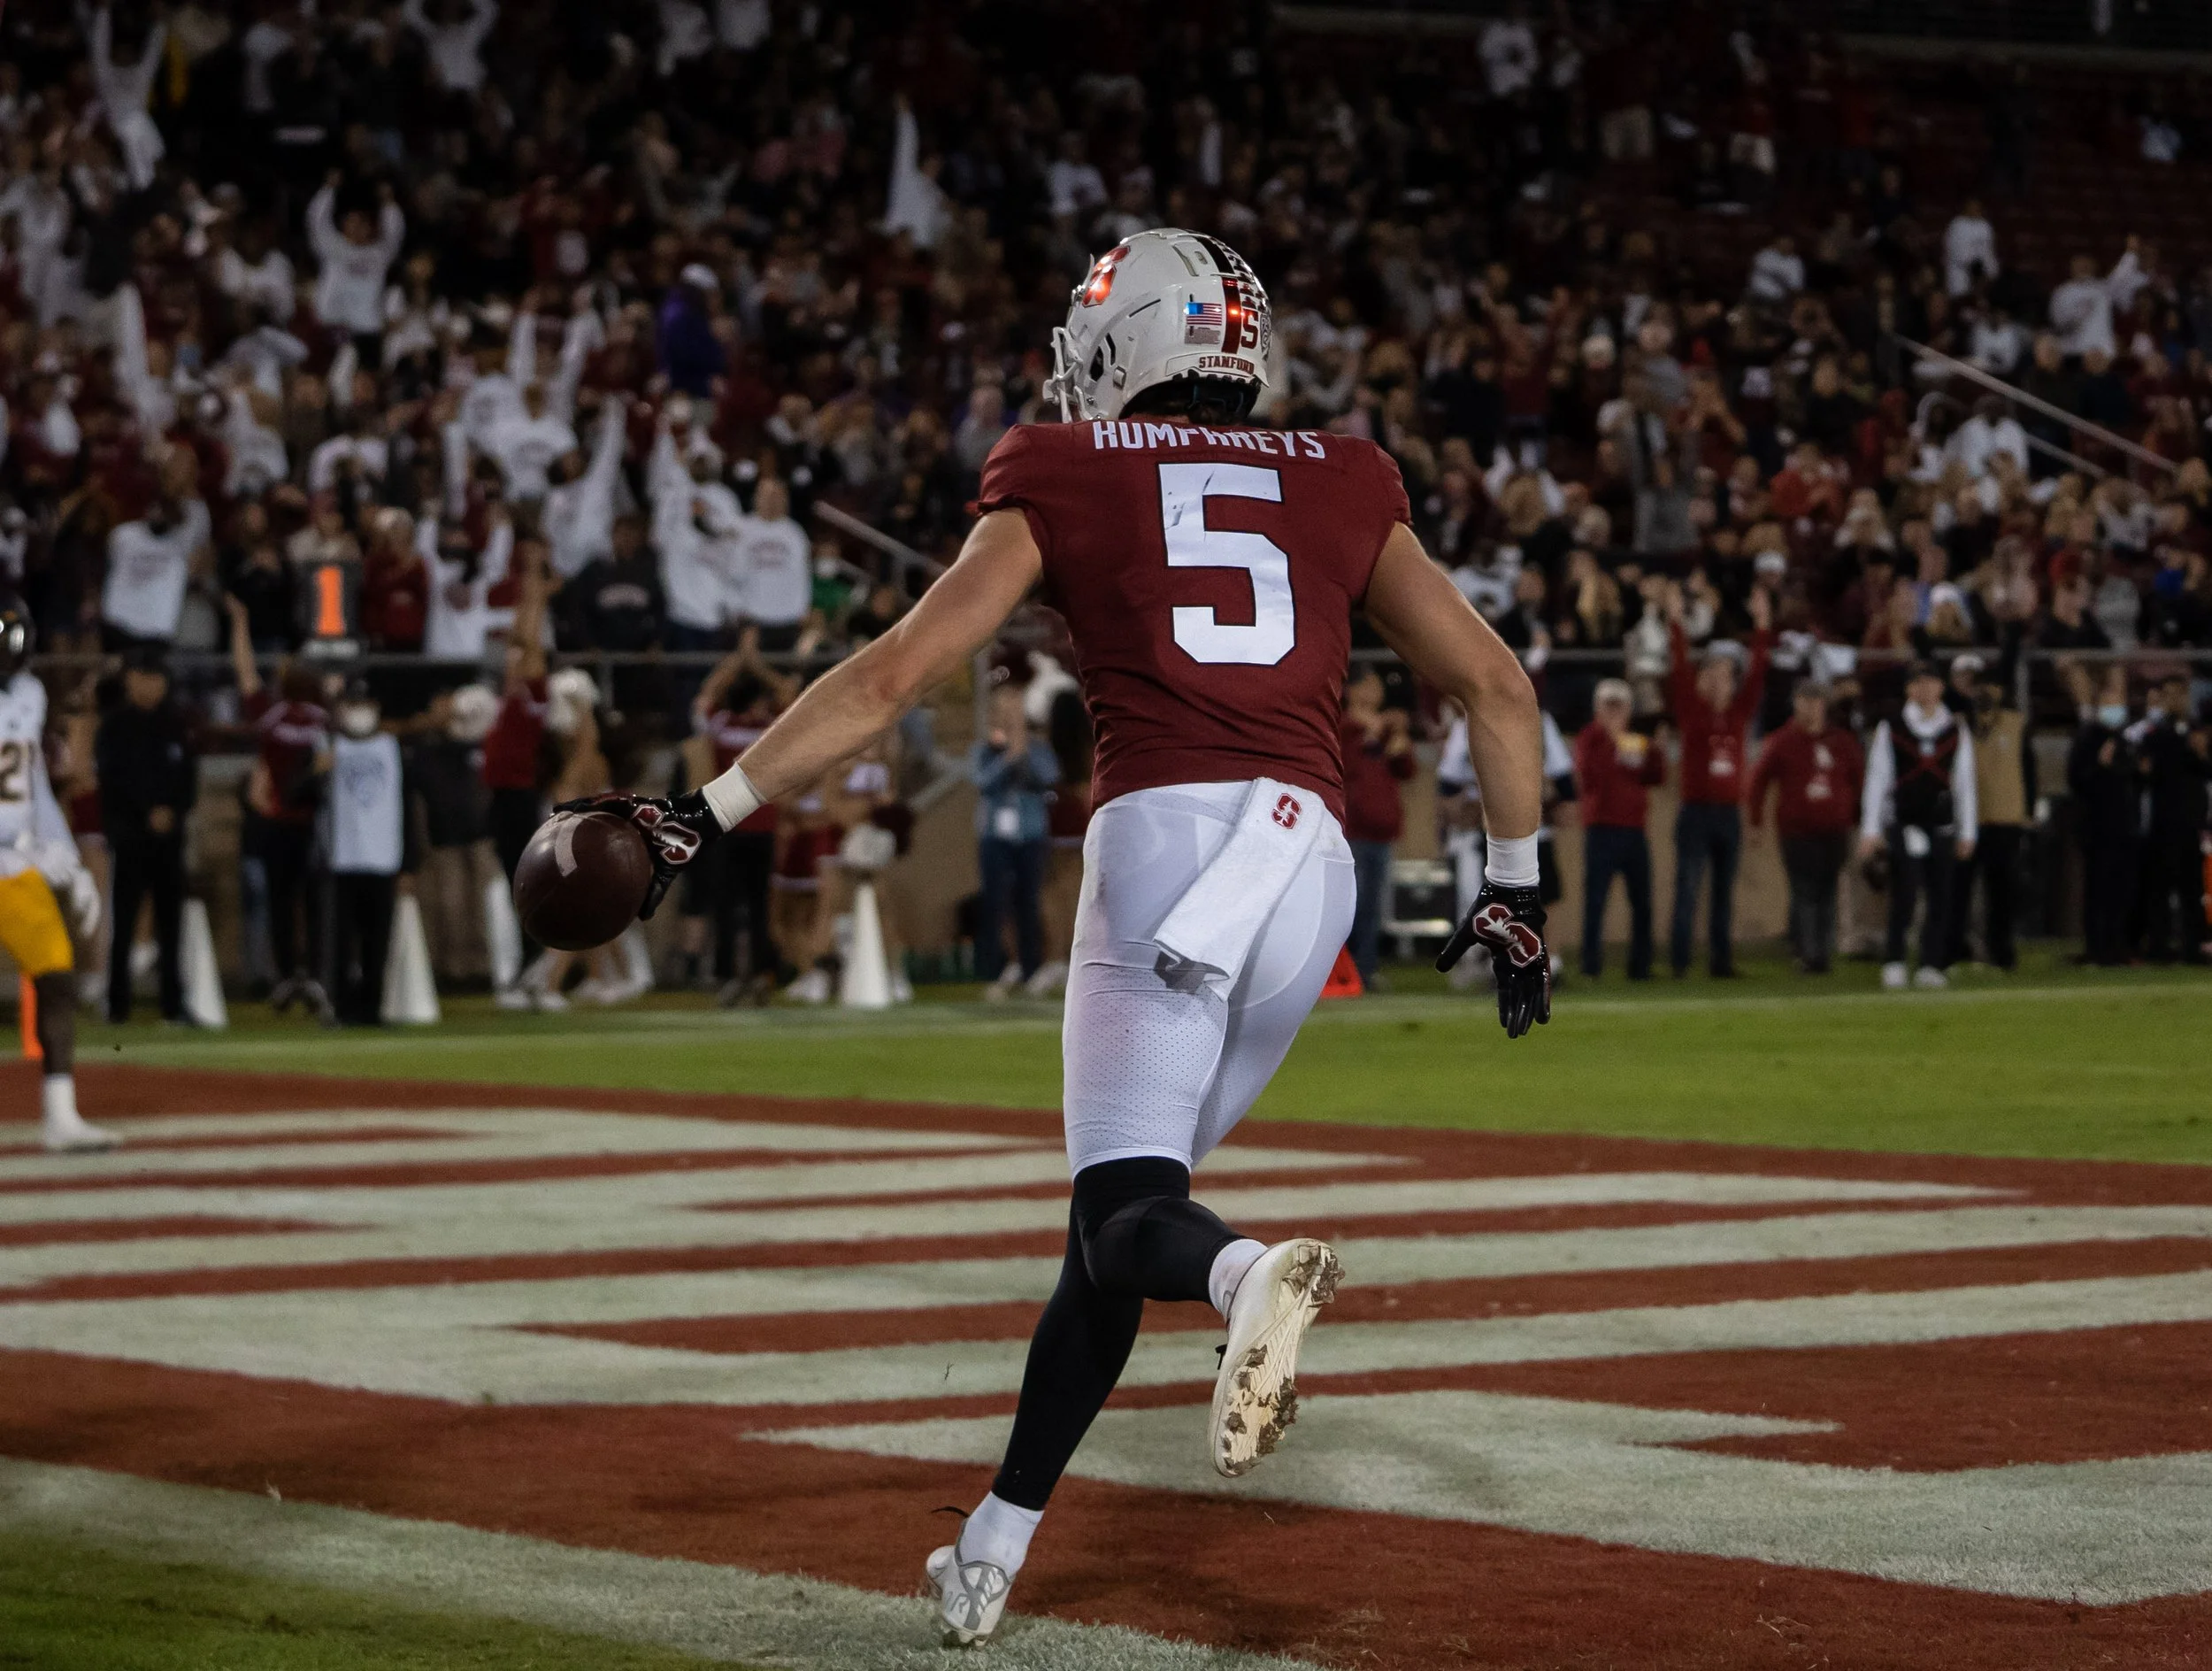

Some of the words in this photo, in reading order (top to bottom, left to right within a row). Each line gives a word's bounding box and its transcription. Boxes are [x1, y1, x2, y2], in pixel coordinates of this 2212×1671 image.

[1240, 308, 1259, 350] S
[1199, 356, 1255, 375] STANFORD
[1093, 420, 1325, 459] HUMPHREYS
[1156, 461, 1297, 666] 5
